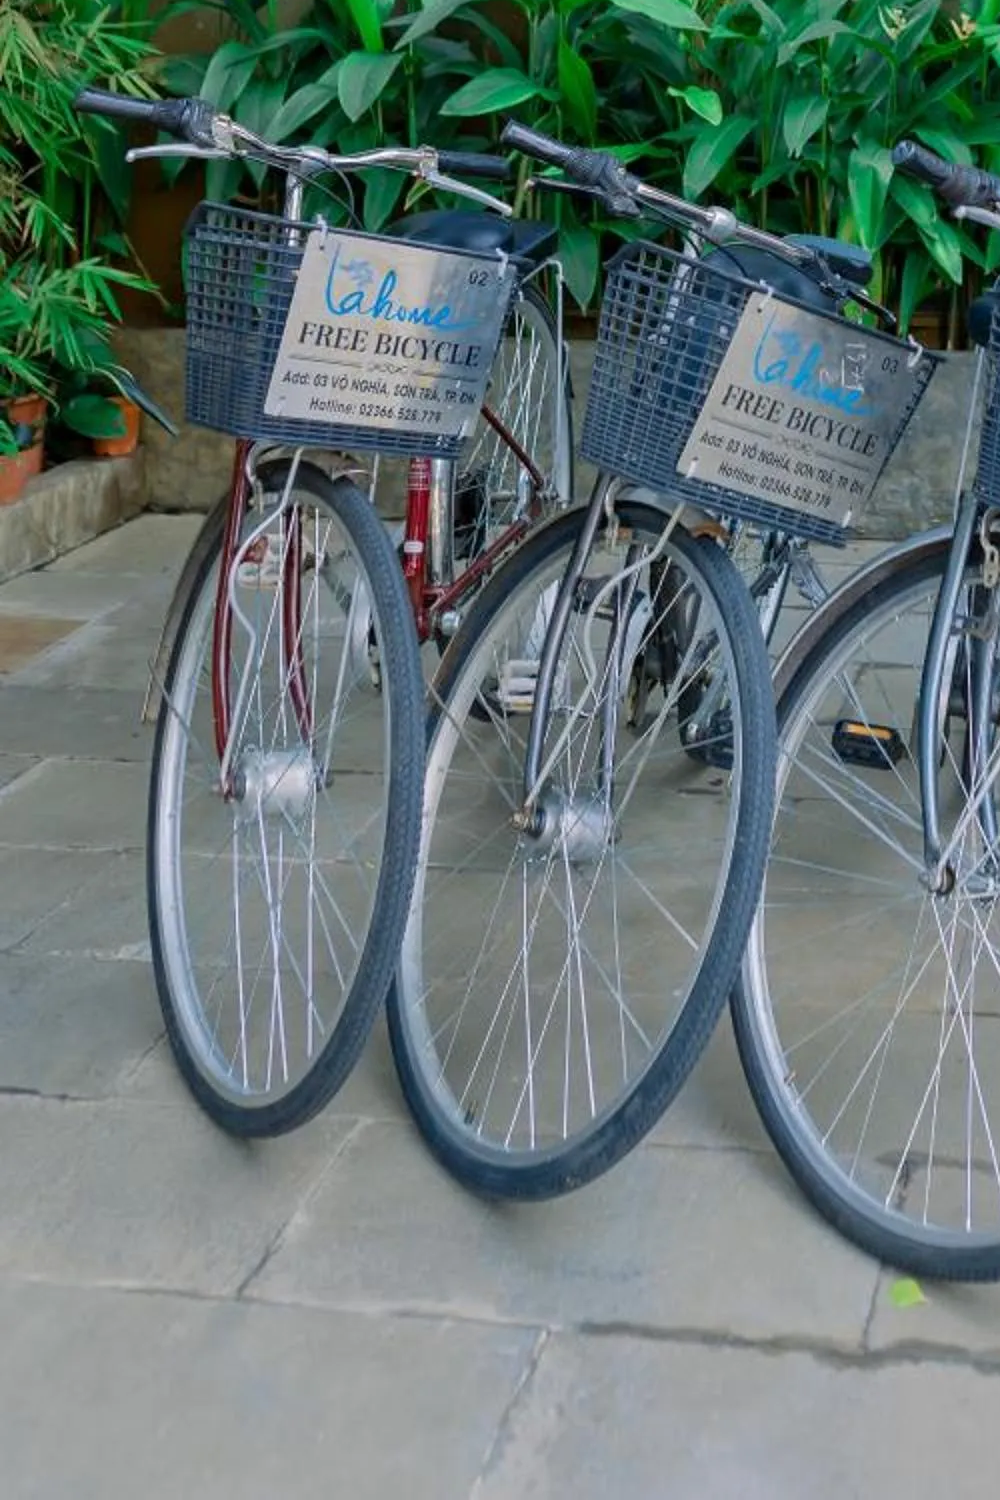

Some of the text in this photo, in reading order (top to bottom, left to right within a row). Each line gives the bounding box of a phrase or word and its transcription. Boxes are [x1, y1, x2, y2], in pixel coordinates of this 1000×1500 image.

[468, 270, 489, 286] 02
[298, 321, 482, 368] FREE BICYCLE
[881, 356, 899, 374] 03
[310, 396, 356, 415] Hotline:
[721, 384, 880, 458] FREE BICYCLE
